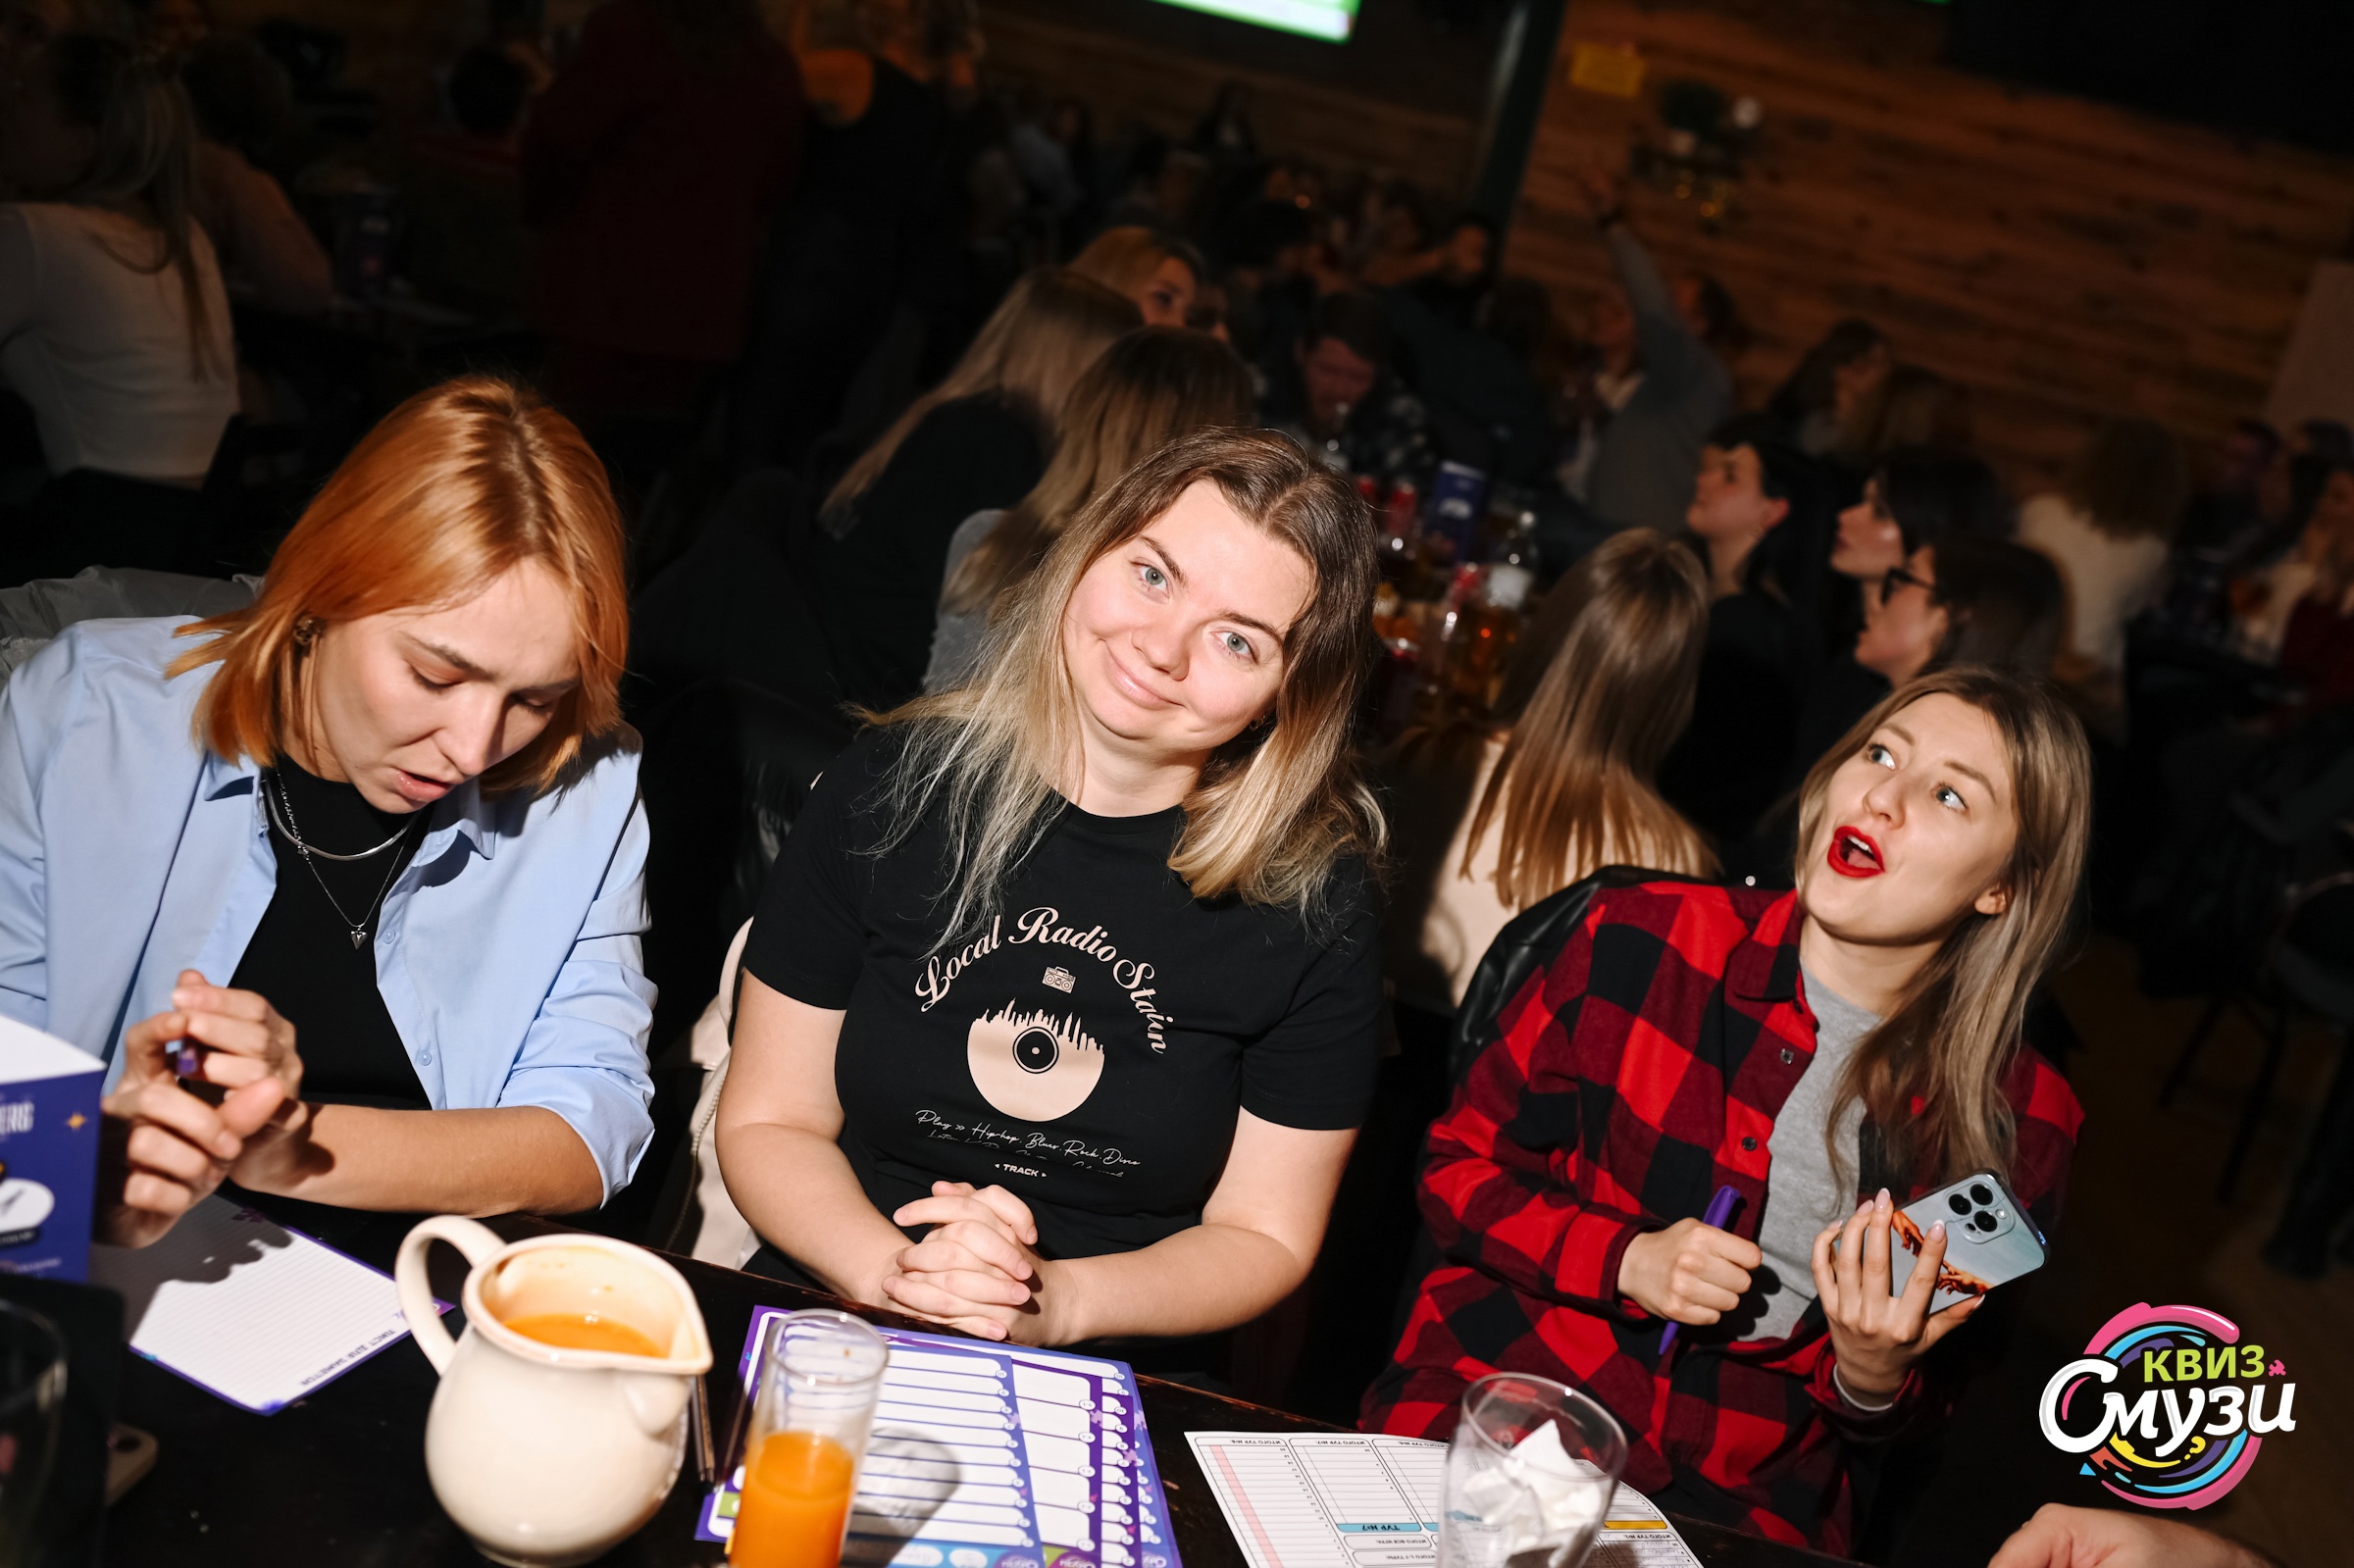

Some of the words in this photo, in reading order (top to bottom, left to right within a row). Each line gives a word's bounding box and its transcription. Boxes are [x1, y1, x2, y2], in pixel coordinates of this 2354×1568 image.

[915, 915, 1001, 1013] Local
[1008, 906, 1116, 962] Radio
[915, 1109, 952, 1130] Play
[1003, 1163, 1040, 1177] TRACK
